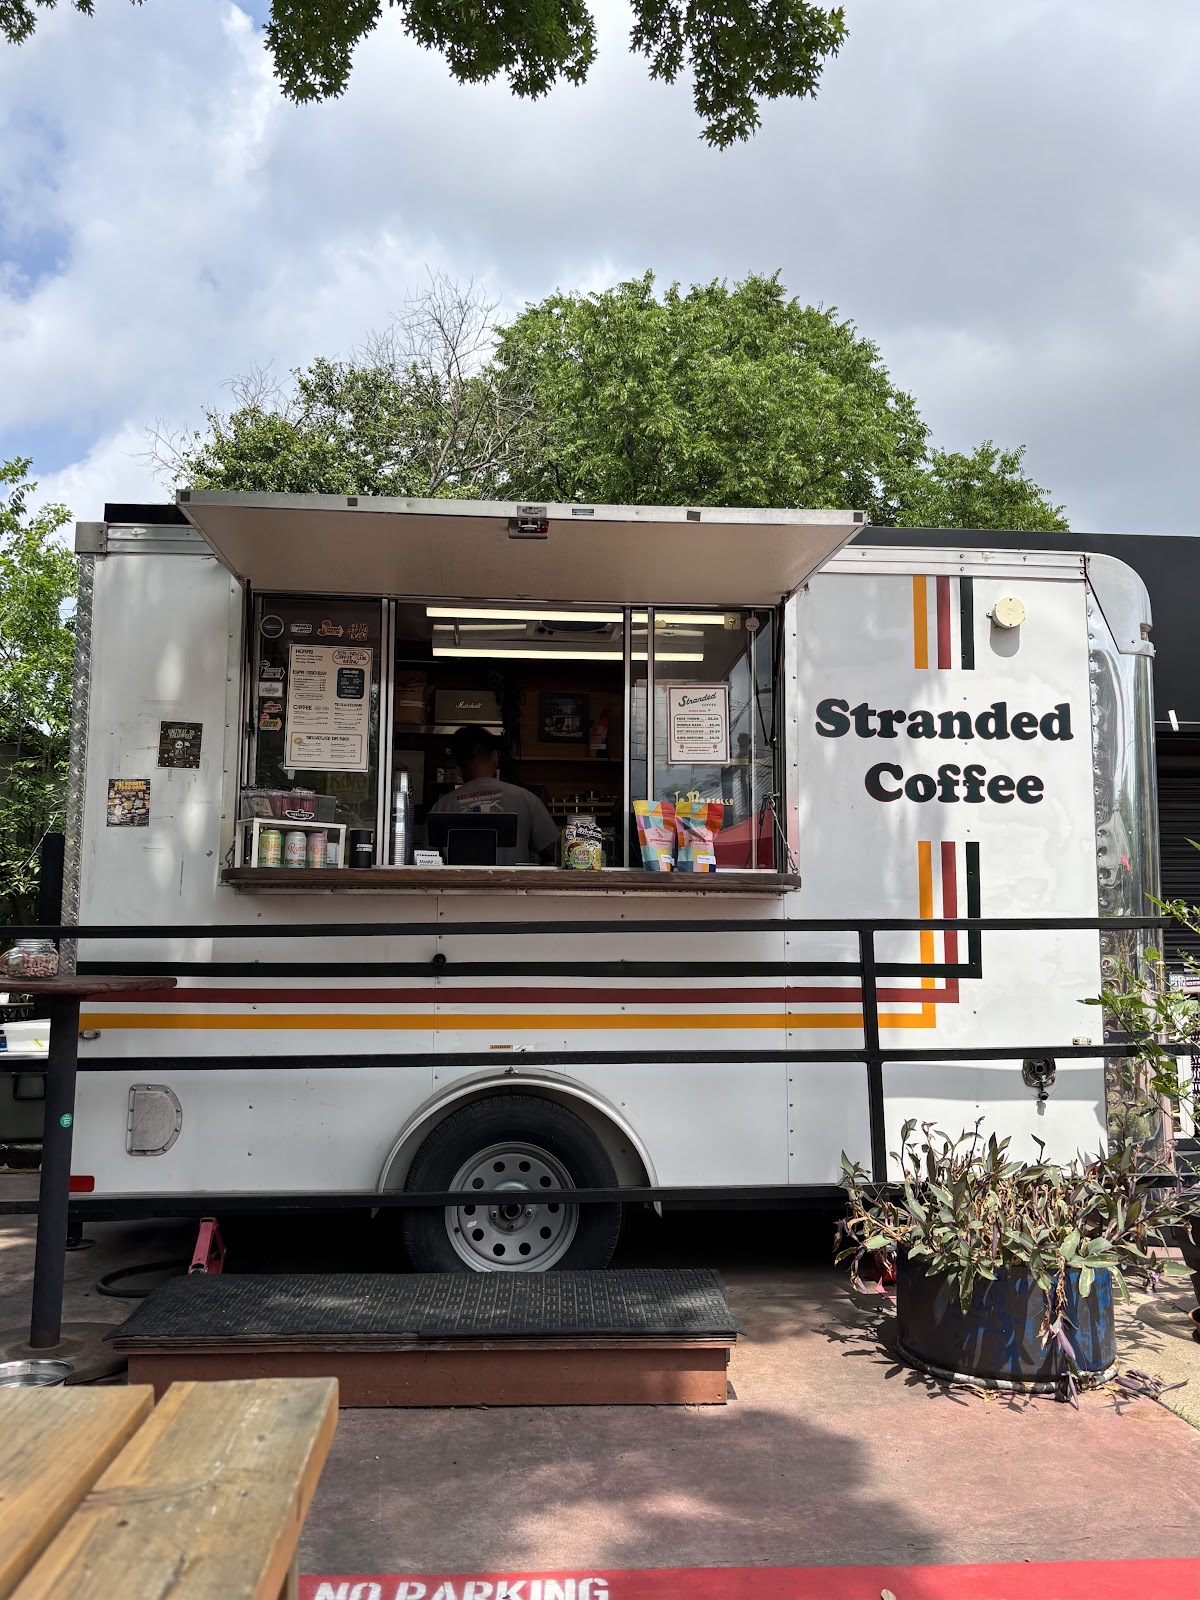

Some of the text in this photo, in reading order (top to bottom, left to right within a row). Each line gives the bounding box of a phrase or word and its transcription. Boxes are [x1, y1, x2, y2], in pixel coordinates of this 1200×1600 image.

[455, 700, 483, 709] Marshall
[678, 692, 718, 708] Stranded
[814, 698, 1075, 741] Stranded
[864, 762, 1045, 804] Coffee
[313, 1577, 610, 1600] NO PARKING
